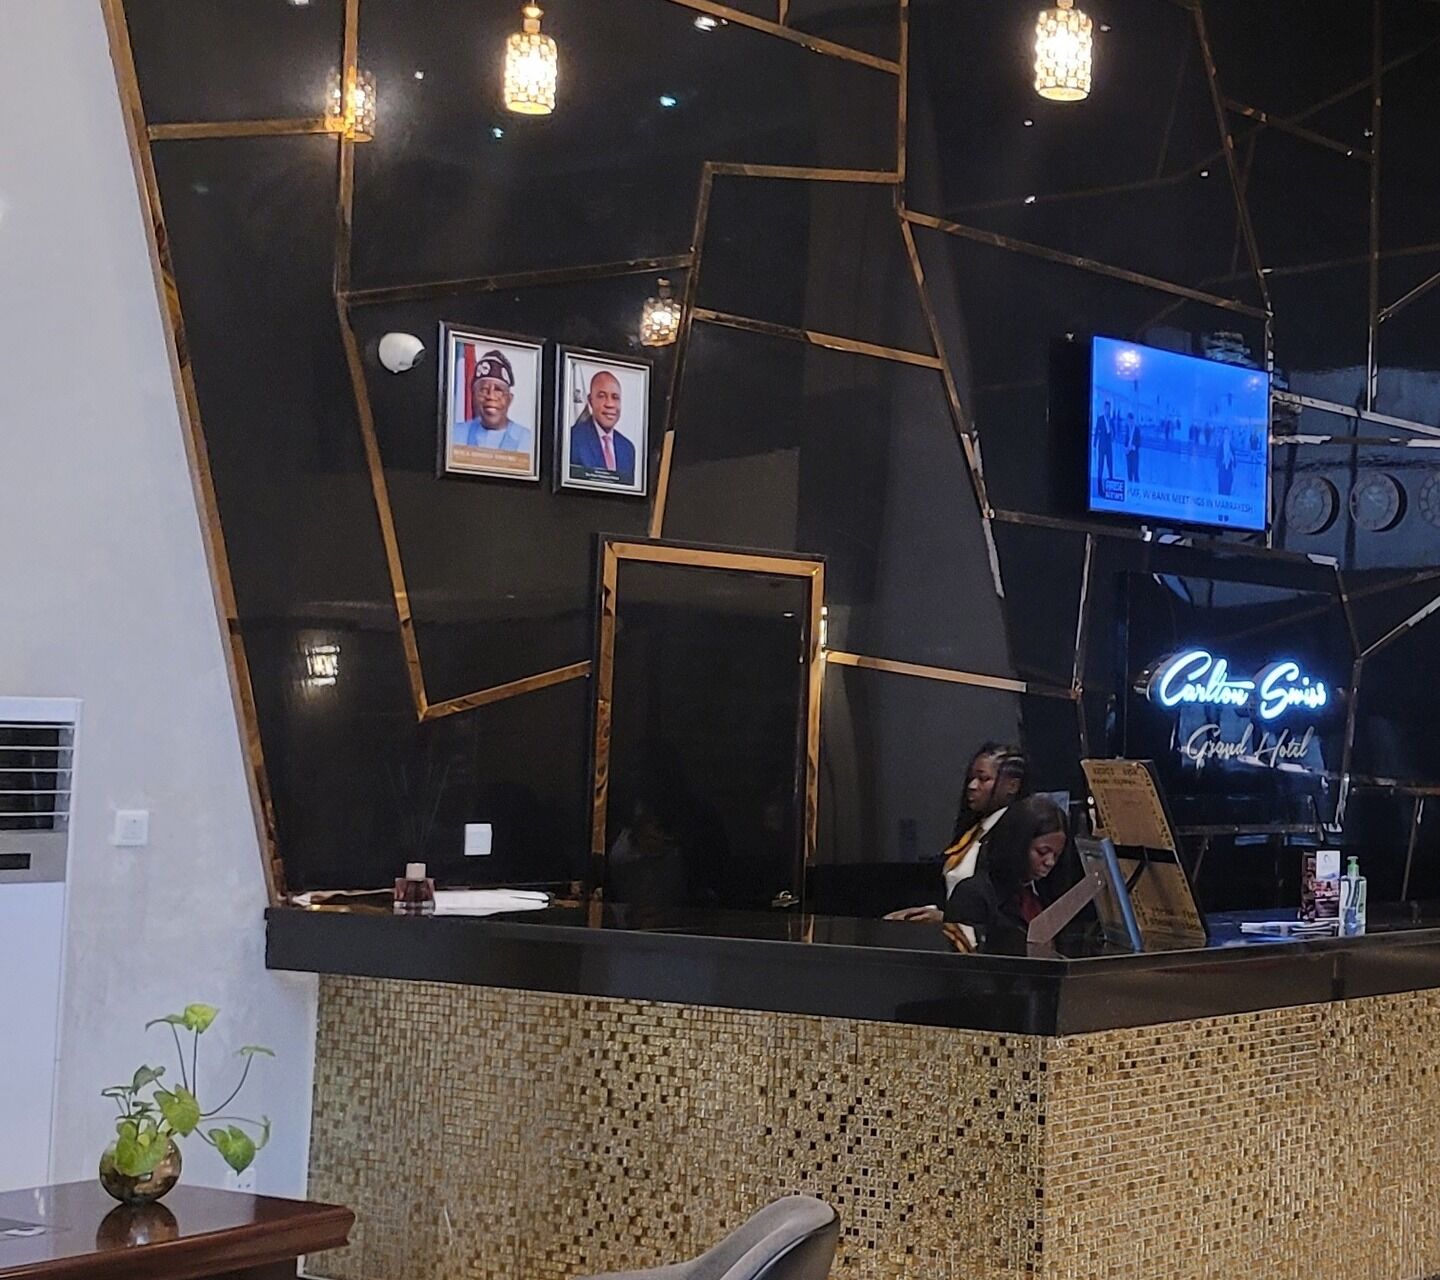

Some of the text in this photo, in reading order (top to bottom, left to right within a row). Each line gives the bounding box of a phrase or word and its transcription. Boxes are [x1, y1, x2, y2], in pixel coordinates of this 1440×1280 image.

[1160, 650, 1328, 720] Carlton Swiss
[1186, 723, 1315, 768] Grand Hotel
